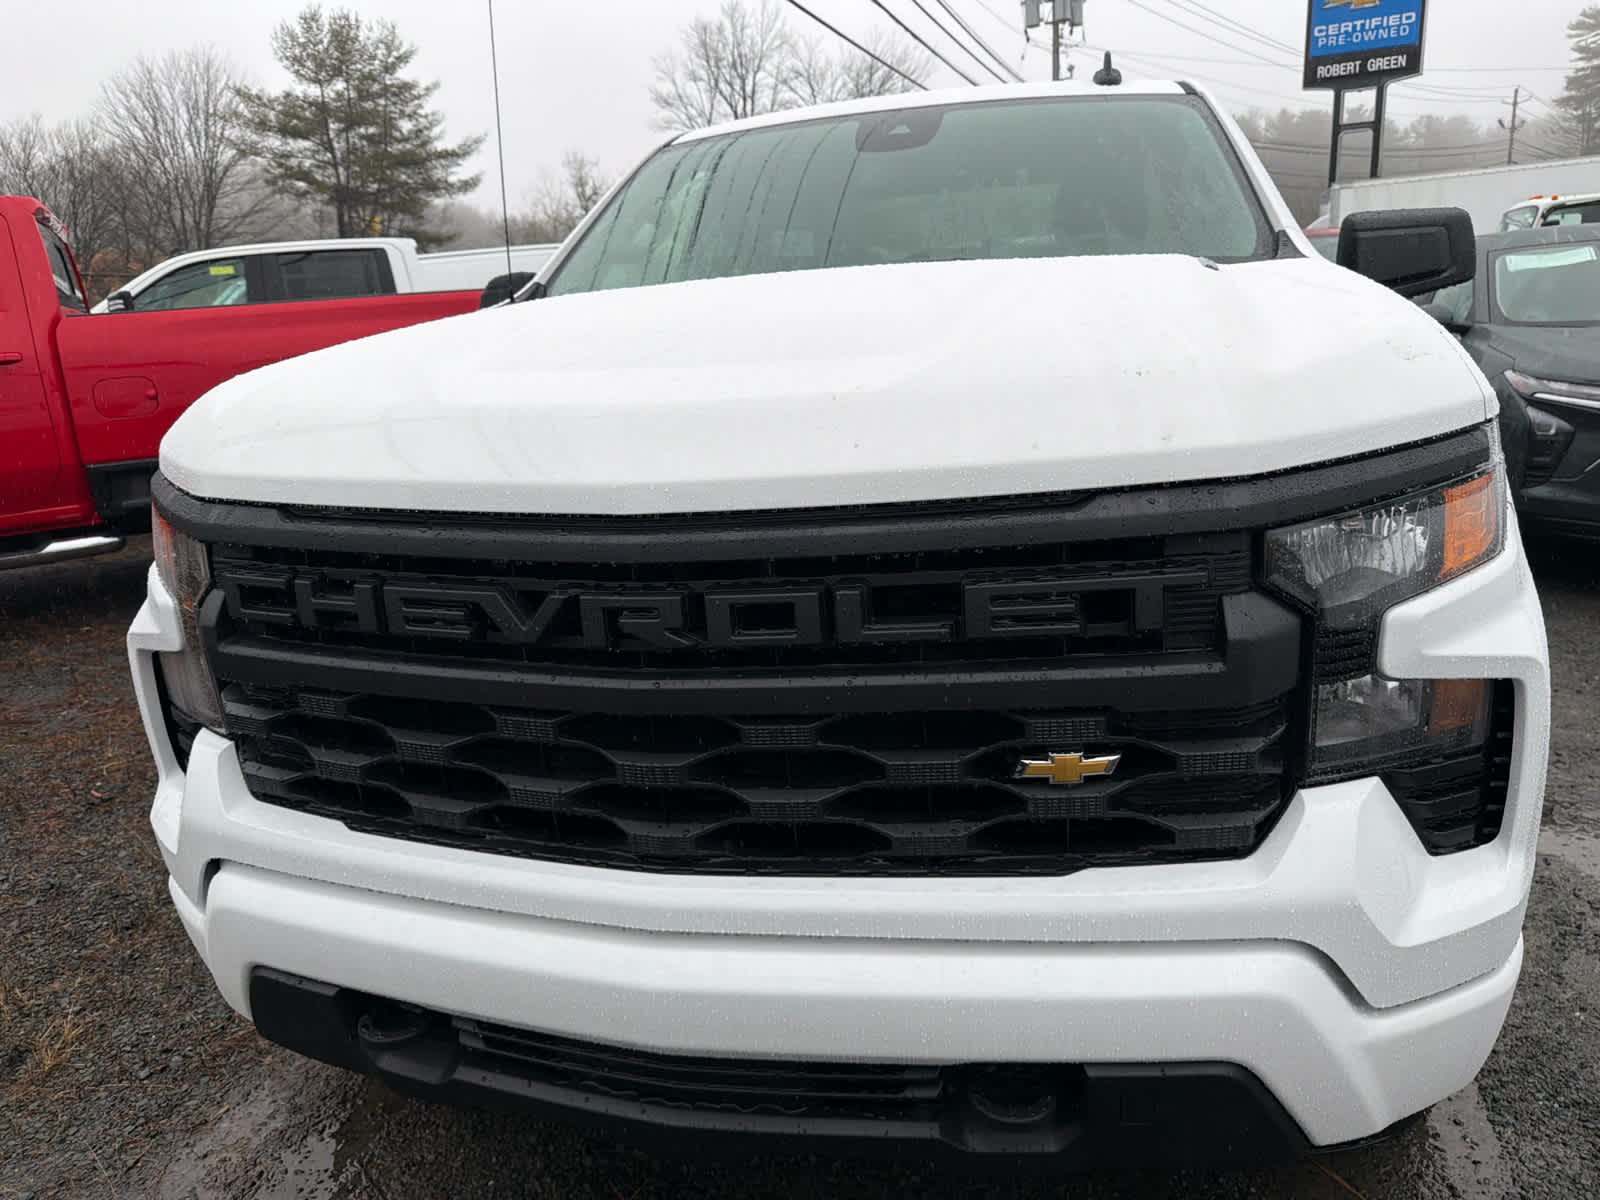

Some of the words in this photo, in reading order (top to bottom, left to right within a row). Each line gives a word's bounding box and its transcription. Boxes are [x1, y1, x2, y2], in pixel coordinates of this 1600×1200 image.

[1314, 12, 1416, 37] CERTIFIED
[1318, 25, 1409, 48] PRE-OWNED
[1317, 60, 1362, 79] ROBERT
[1367, 54, 1407, 72] GREEN
[221, 566, 1210, 650] CHEVROLET
